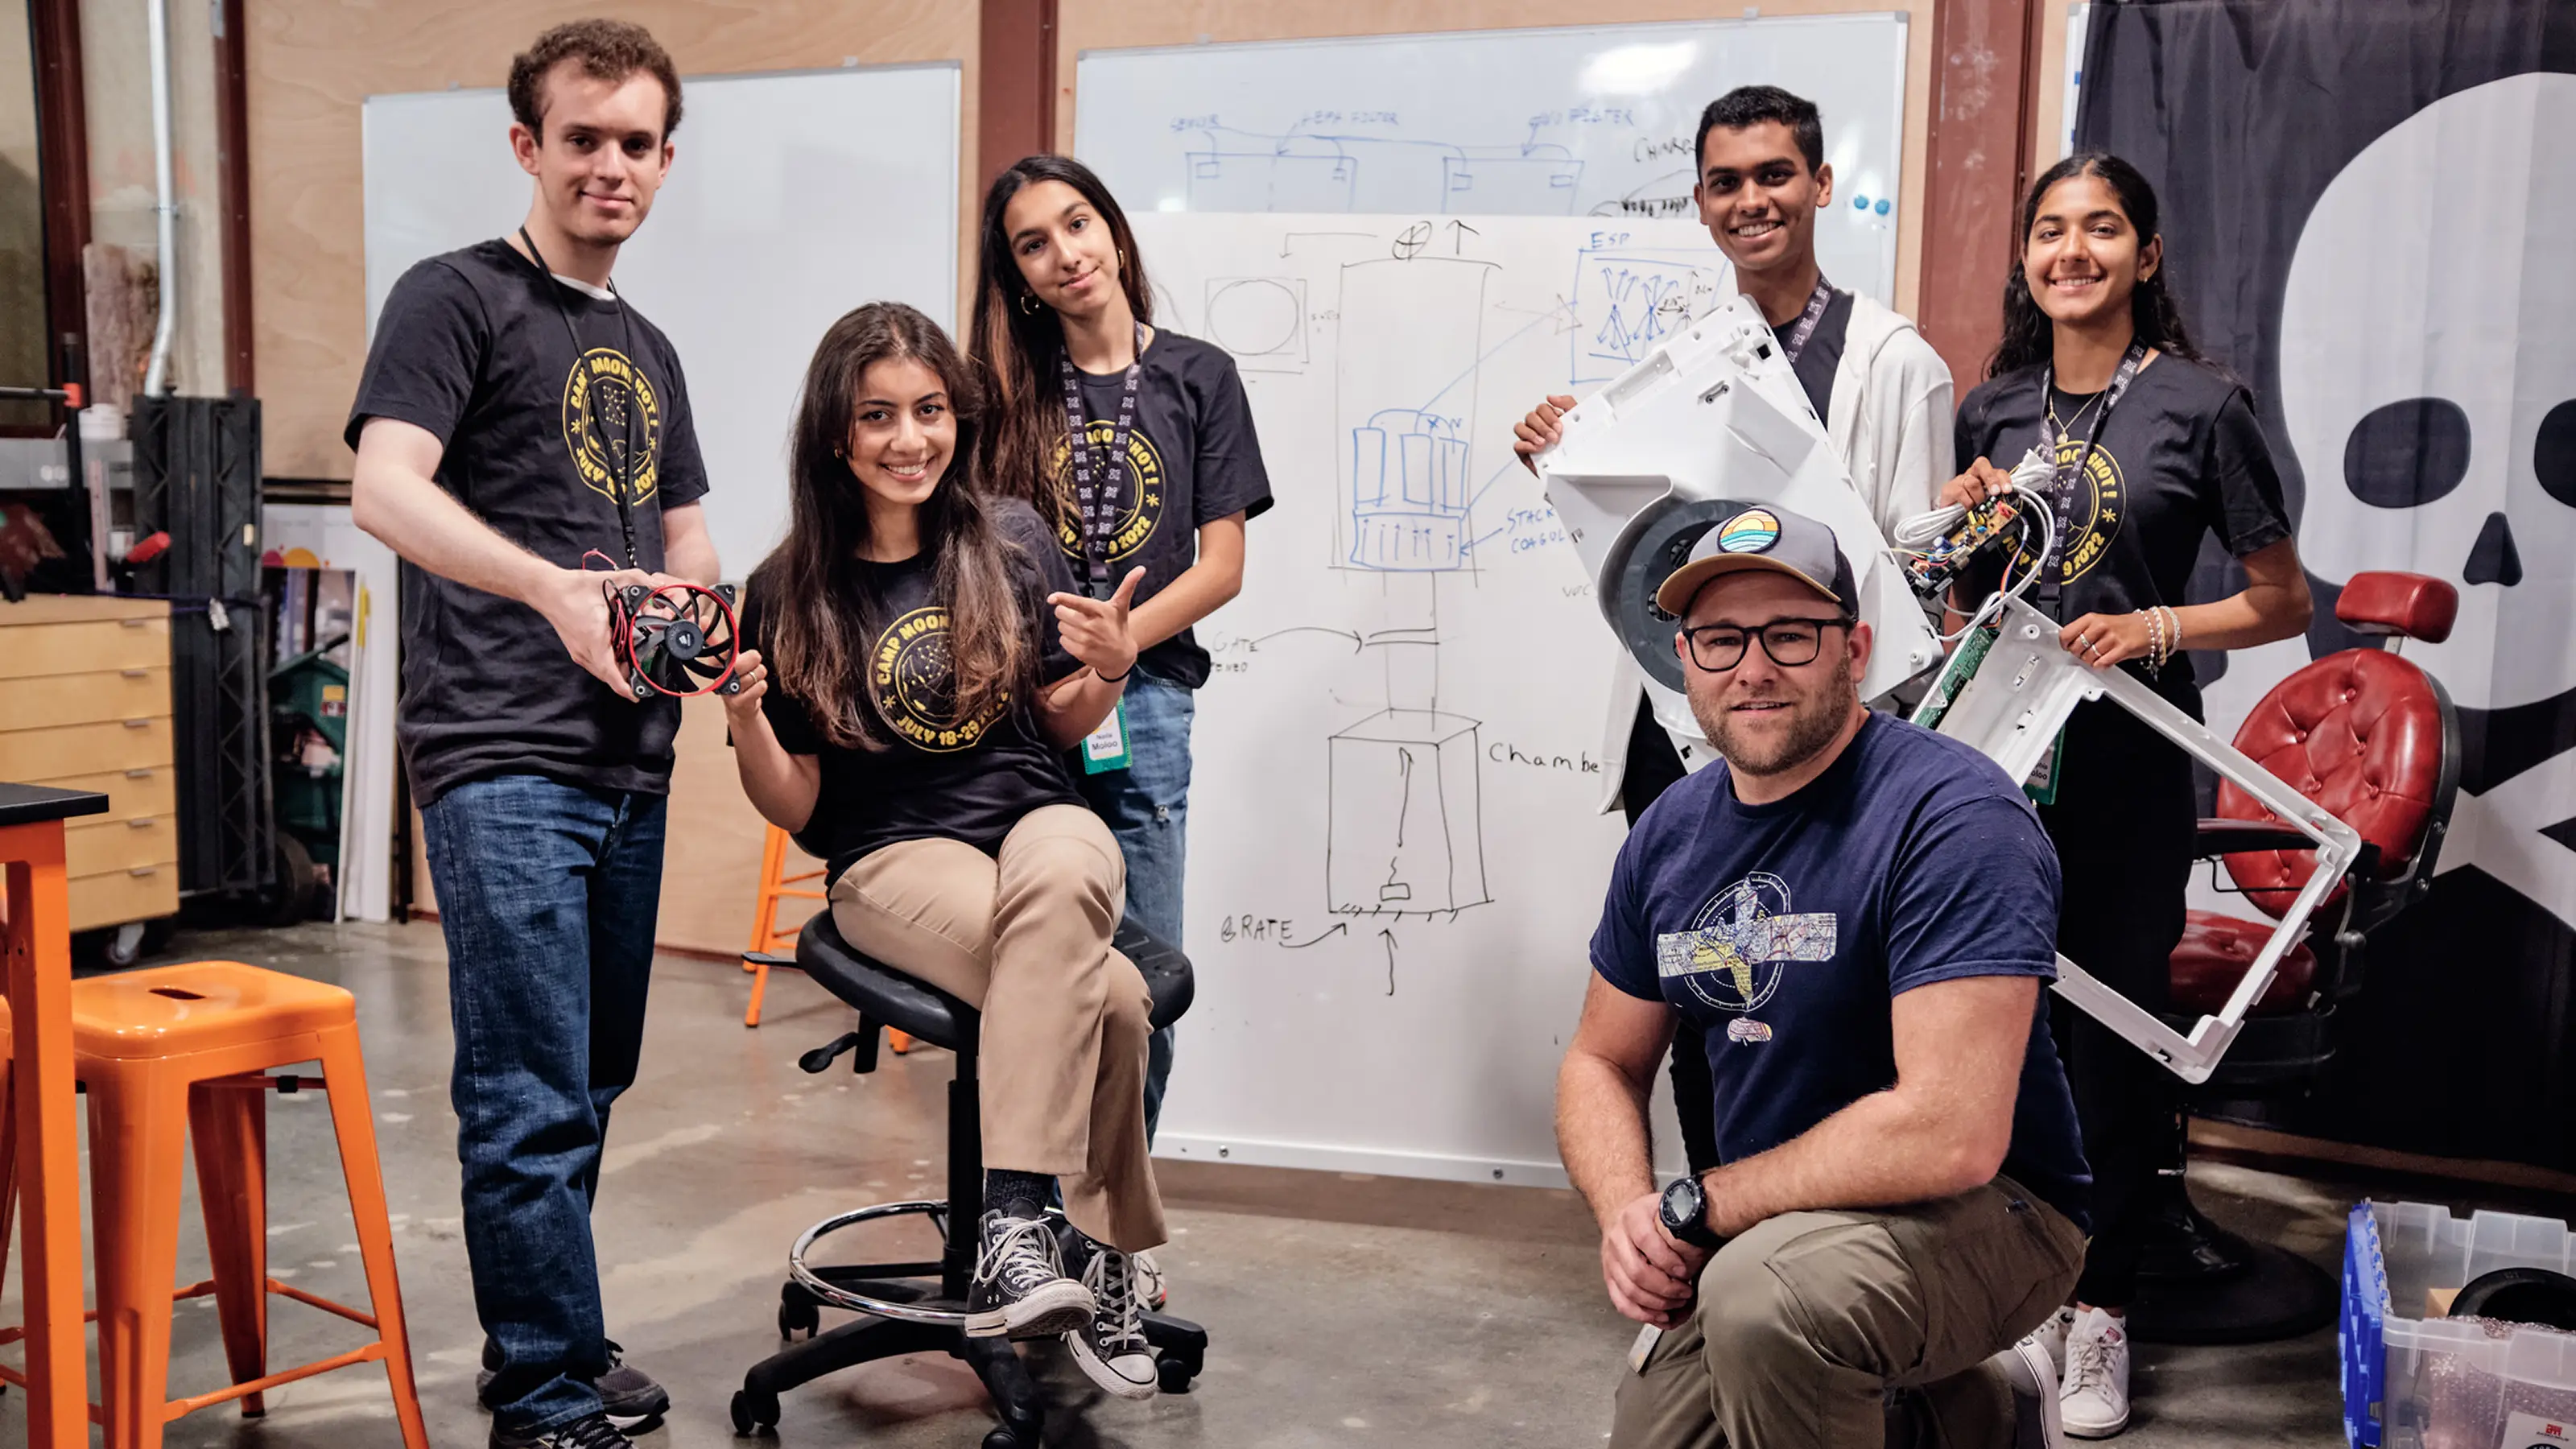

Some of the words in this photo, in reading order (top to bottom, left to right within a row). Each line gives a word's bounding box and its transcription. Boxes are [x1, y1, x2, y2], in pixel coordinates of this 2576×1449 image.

[1591, 232, 1630, 248] ESP
[1117, 515, 1152, 551] 2022
[1507, 507, 1554, 535] STACK
[2074, 531, 2106, 571] 2022
[1212, 630, 1259, 655] GATE
[876, 636, 902, 685] CAMP
[896, 715, 937, 744] JULY
